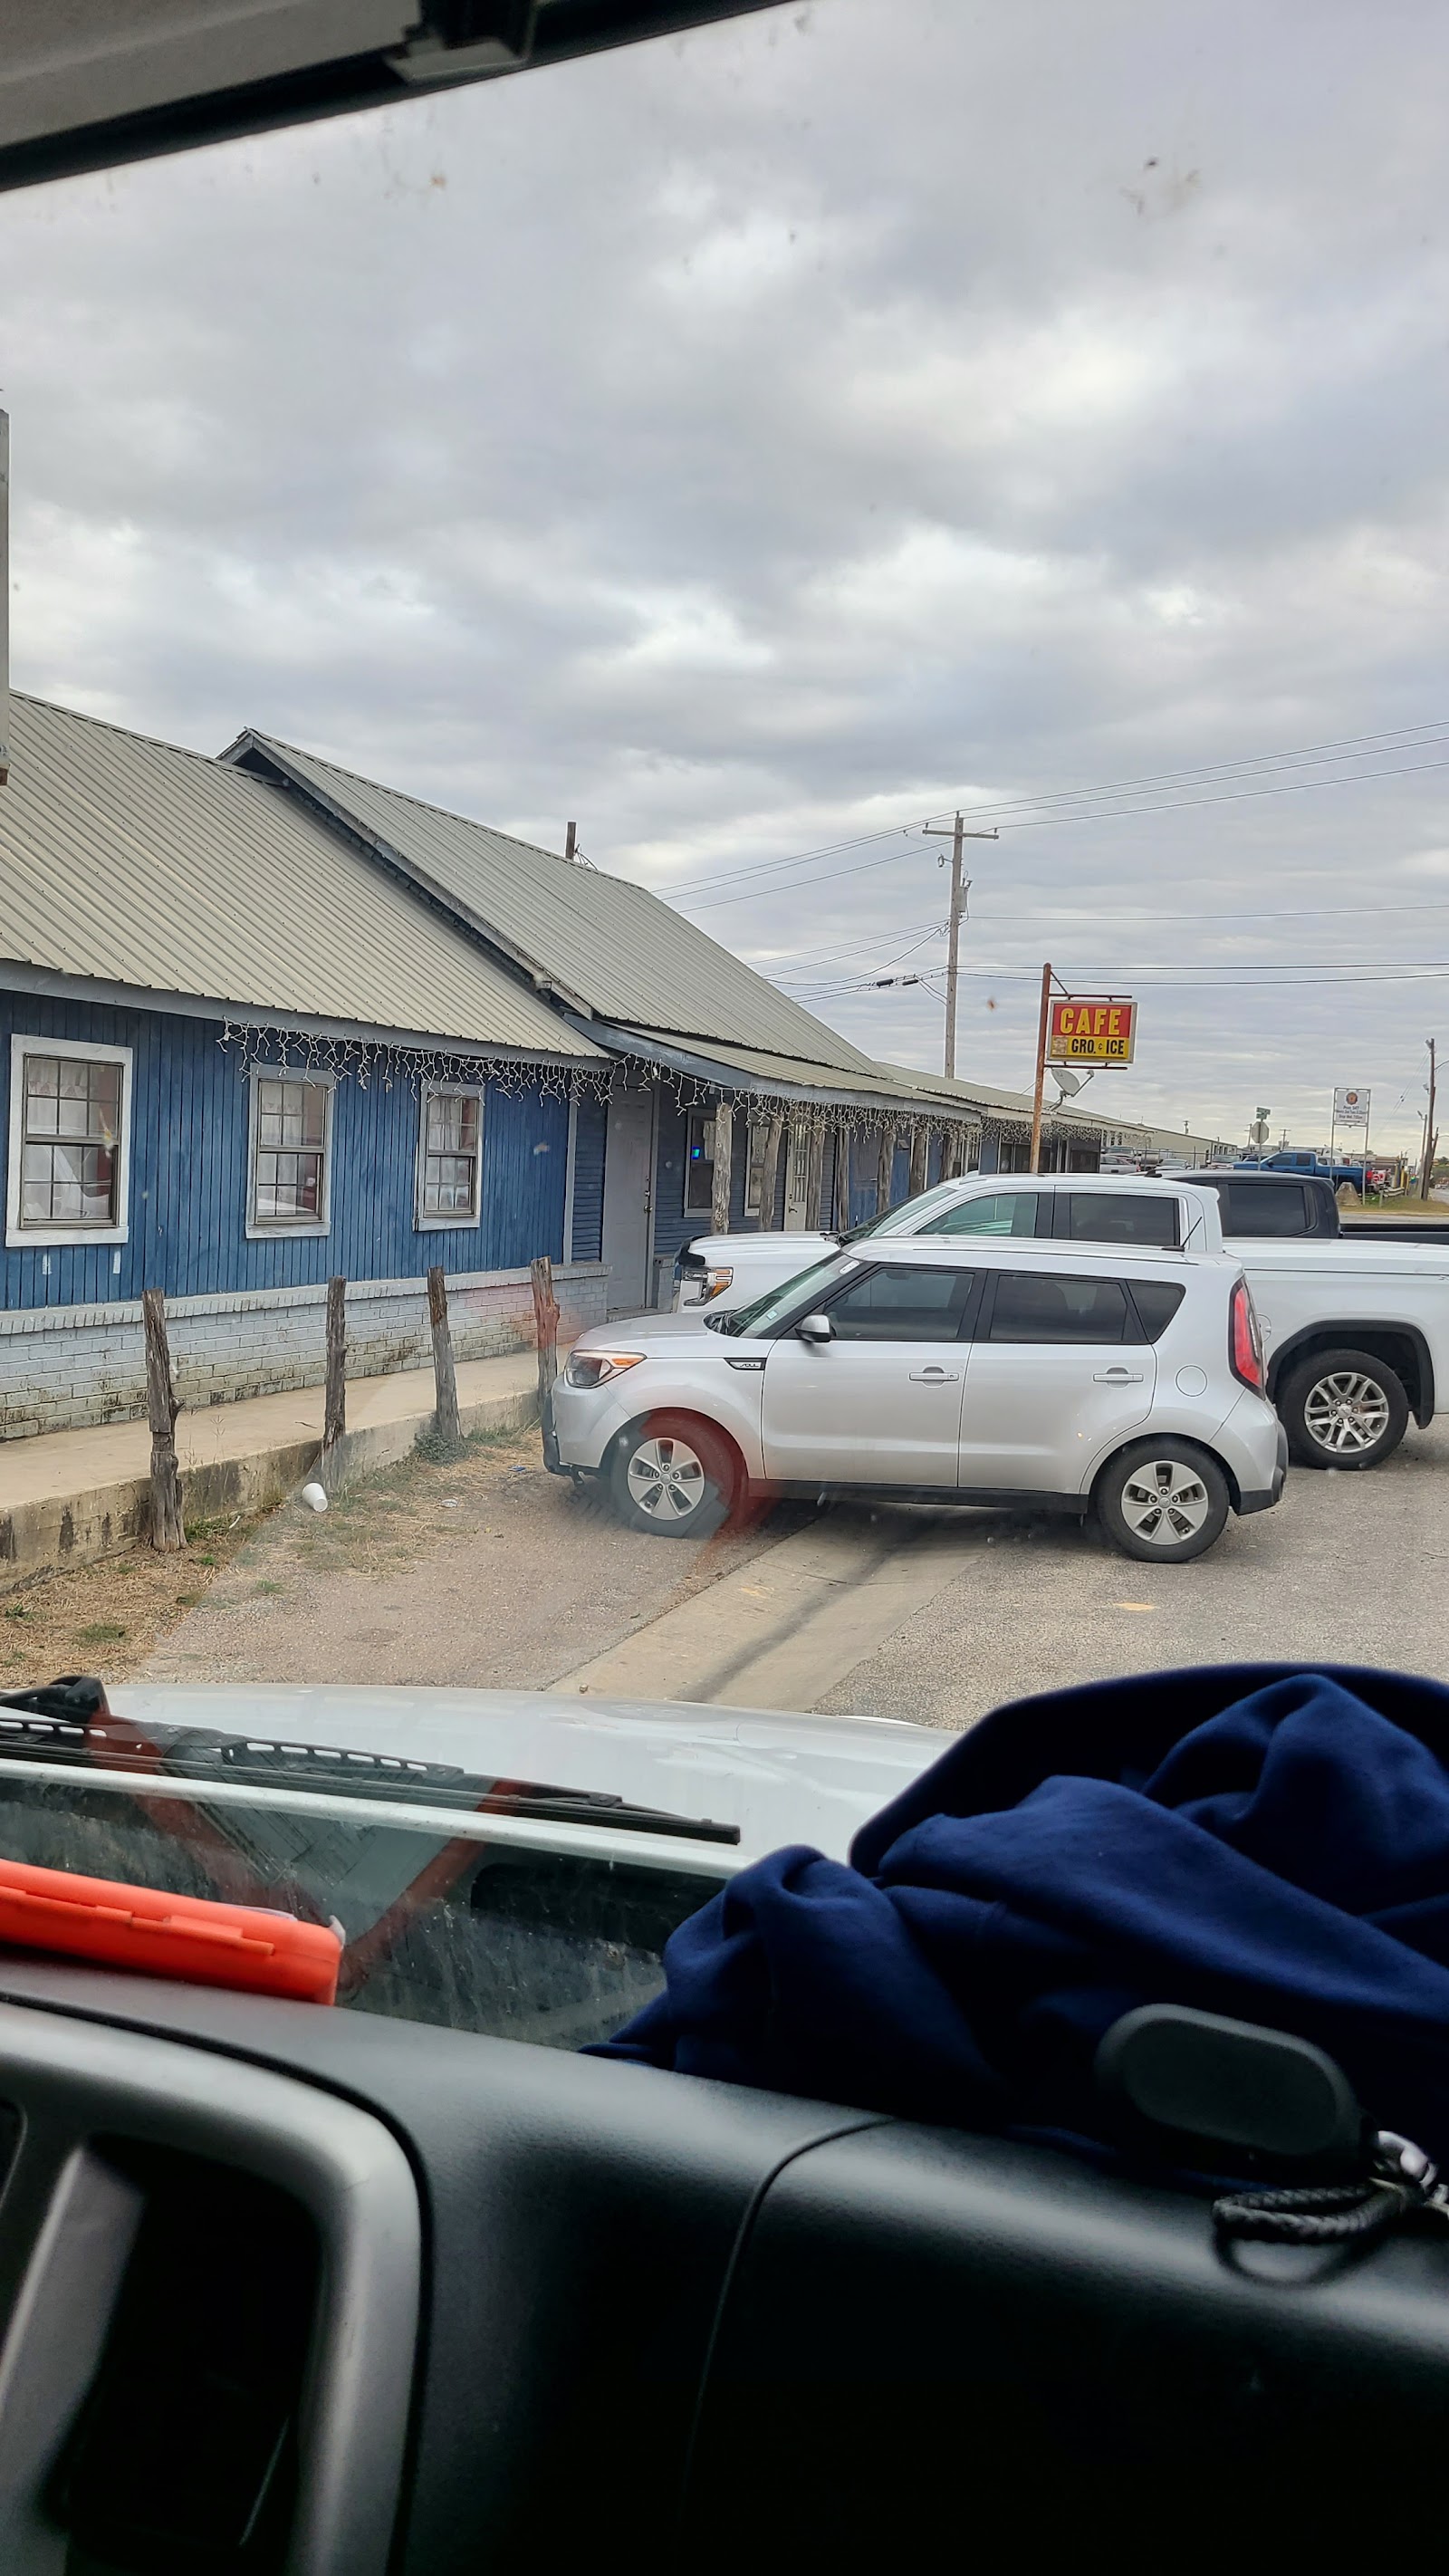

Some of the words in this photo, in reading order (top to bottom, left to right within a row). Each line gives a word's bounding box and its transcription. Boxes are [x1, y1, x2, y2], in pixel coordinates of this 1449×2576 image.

[1060, 1007, 1122, 1035] CAFE
[1071, 1038, 1096, 1054] GRO.
[1106, 1039, 1125, 1054] ICE
